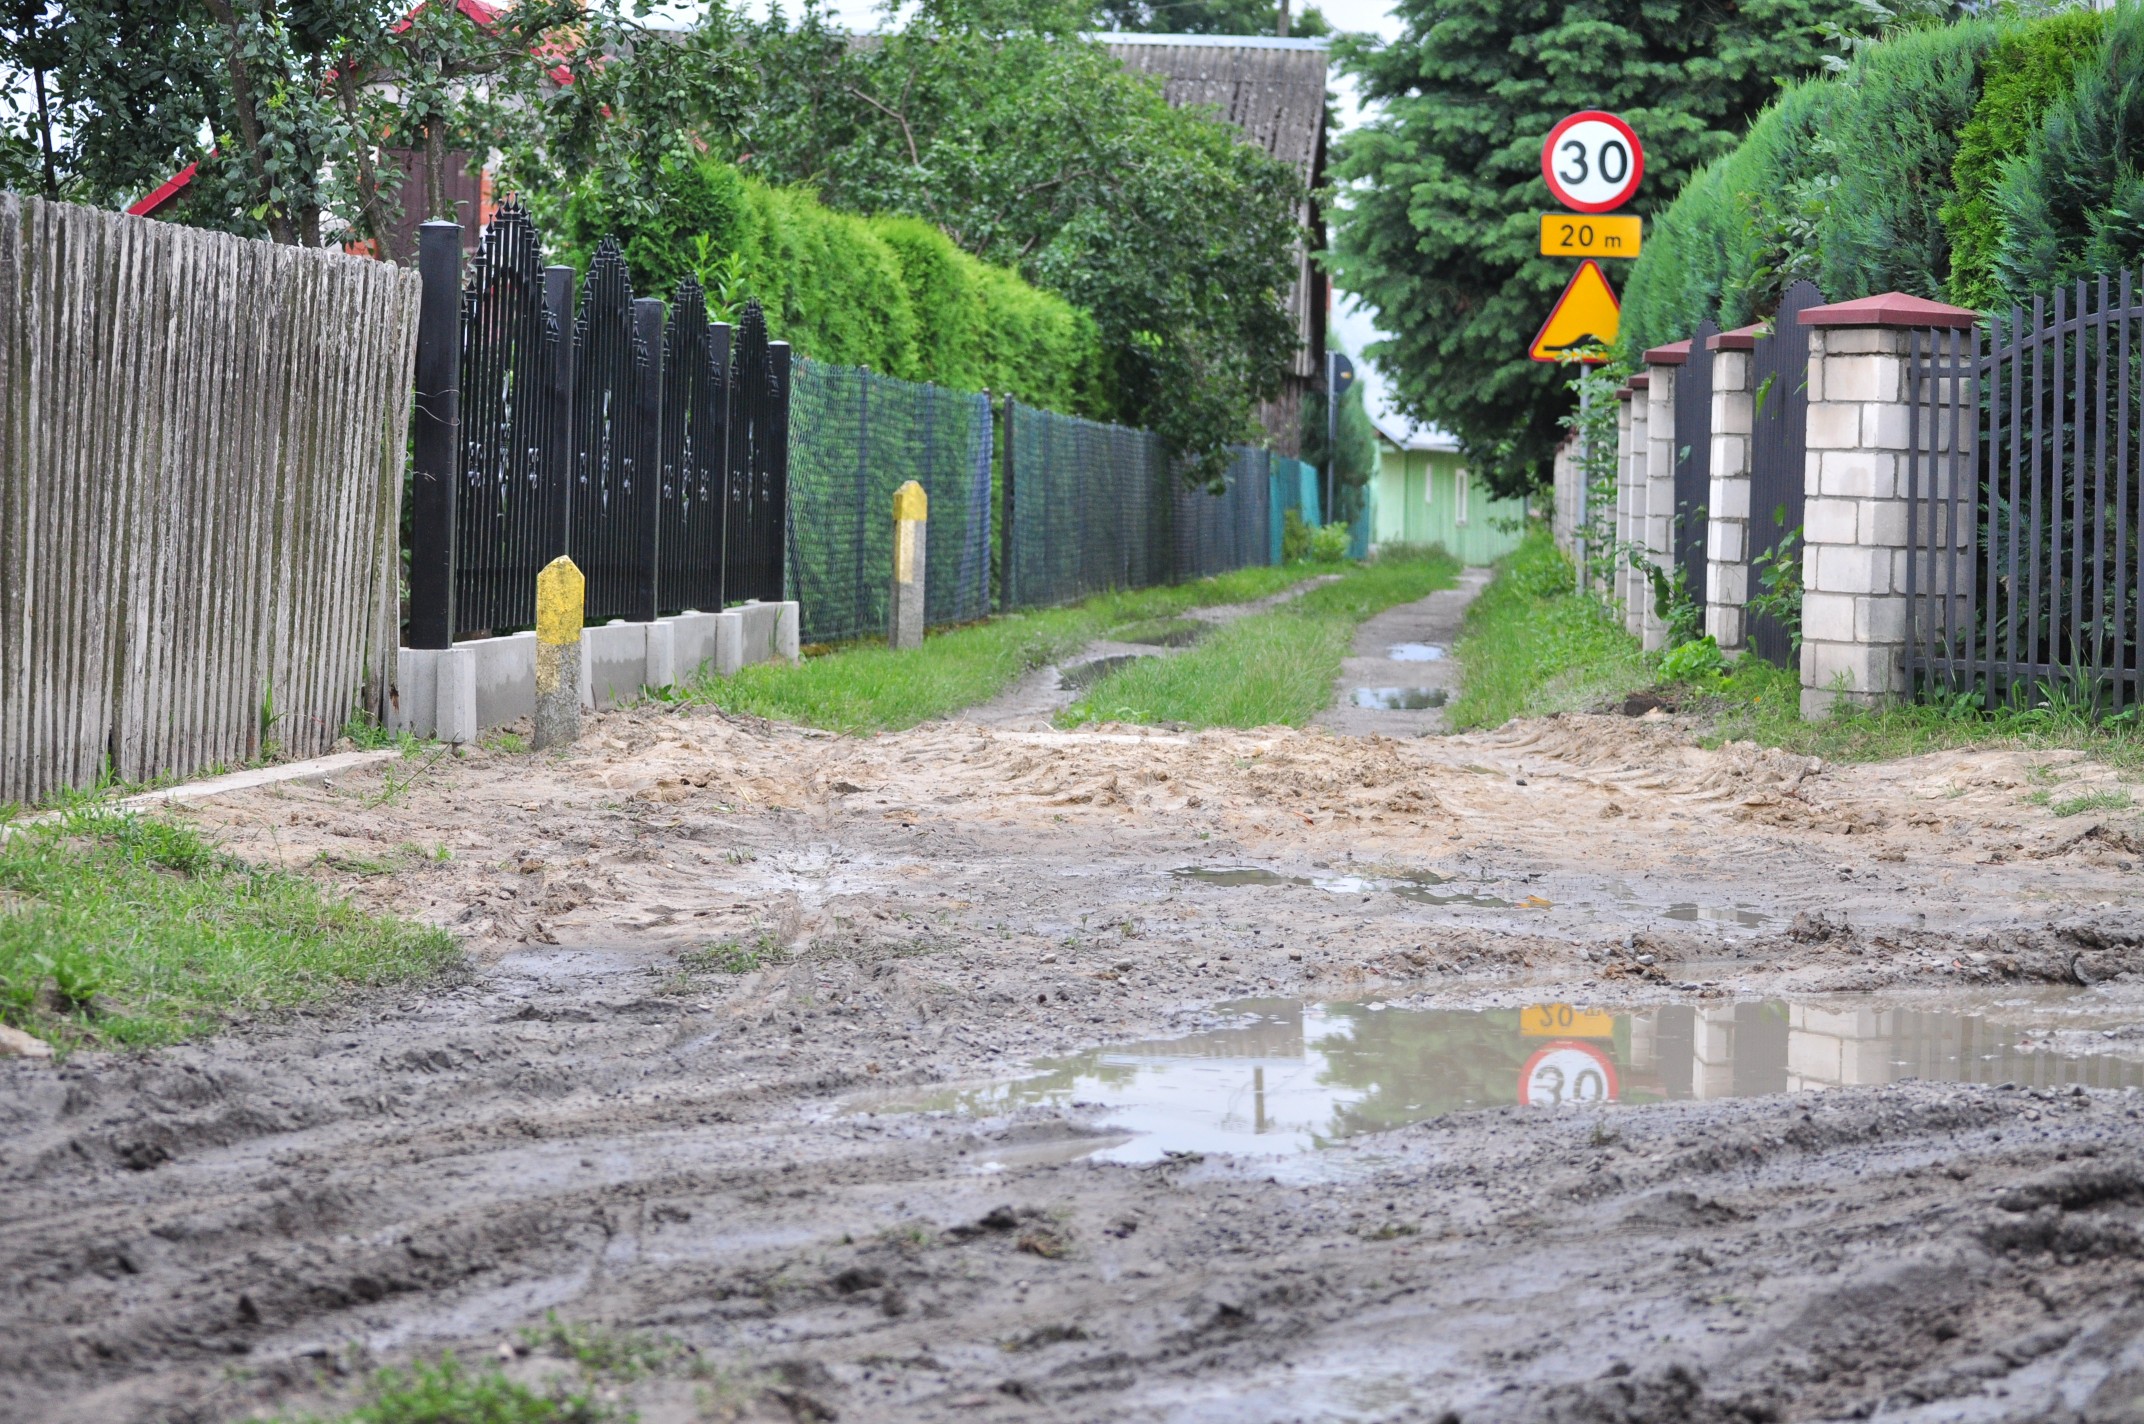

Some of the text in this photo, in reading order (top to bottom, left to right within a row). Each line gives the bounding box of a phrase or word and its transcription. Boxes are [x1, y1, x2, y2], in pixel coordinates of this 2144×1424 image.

[1560, 140, 1627, 185] 30
[1560, 225, 1621, 247] 20 m
